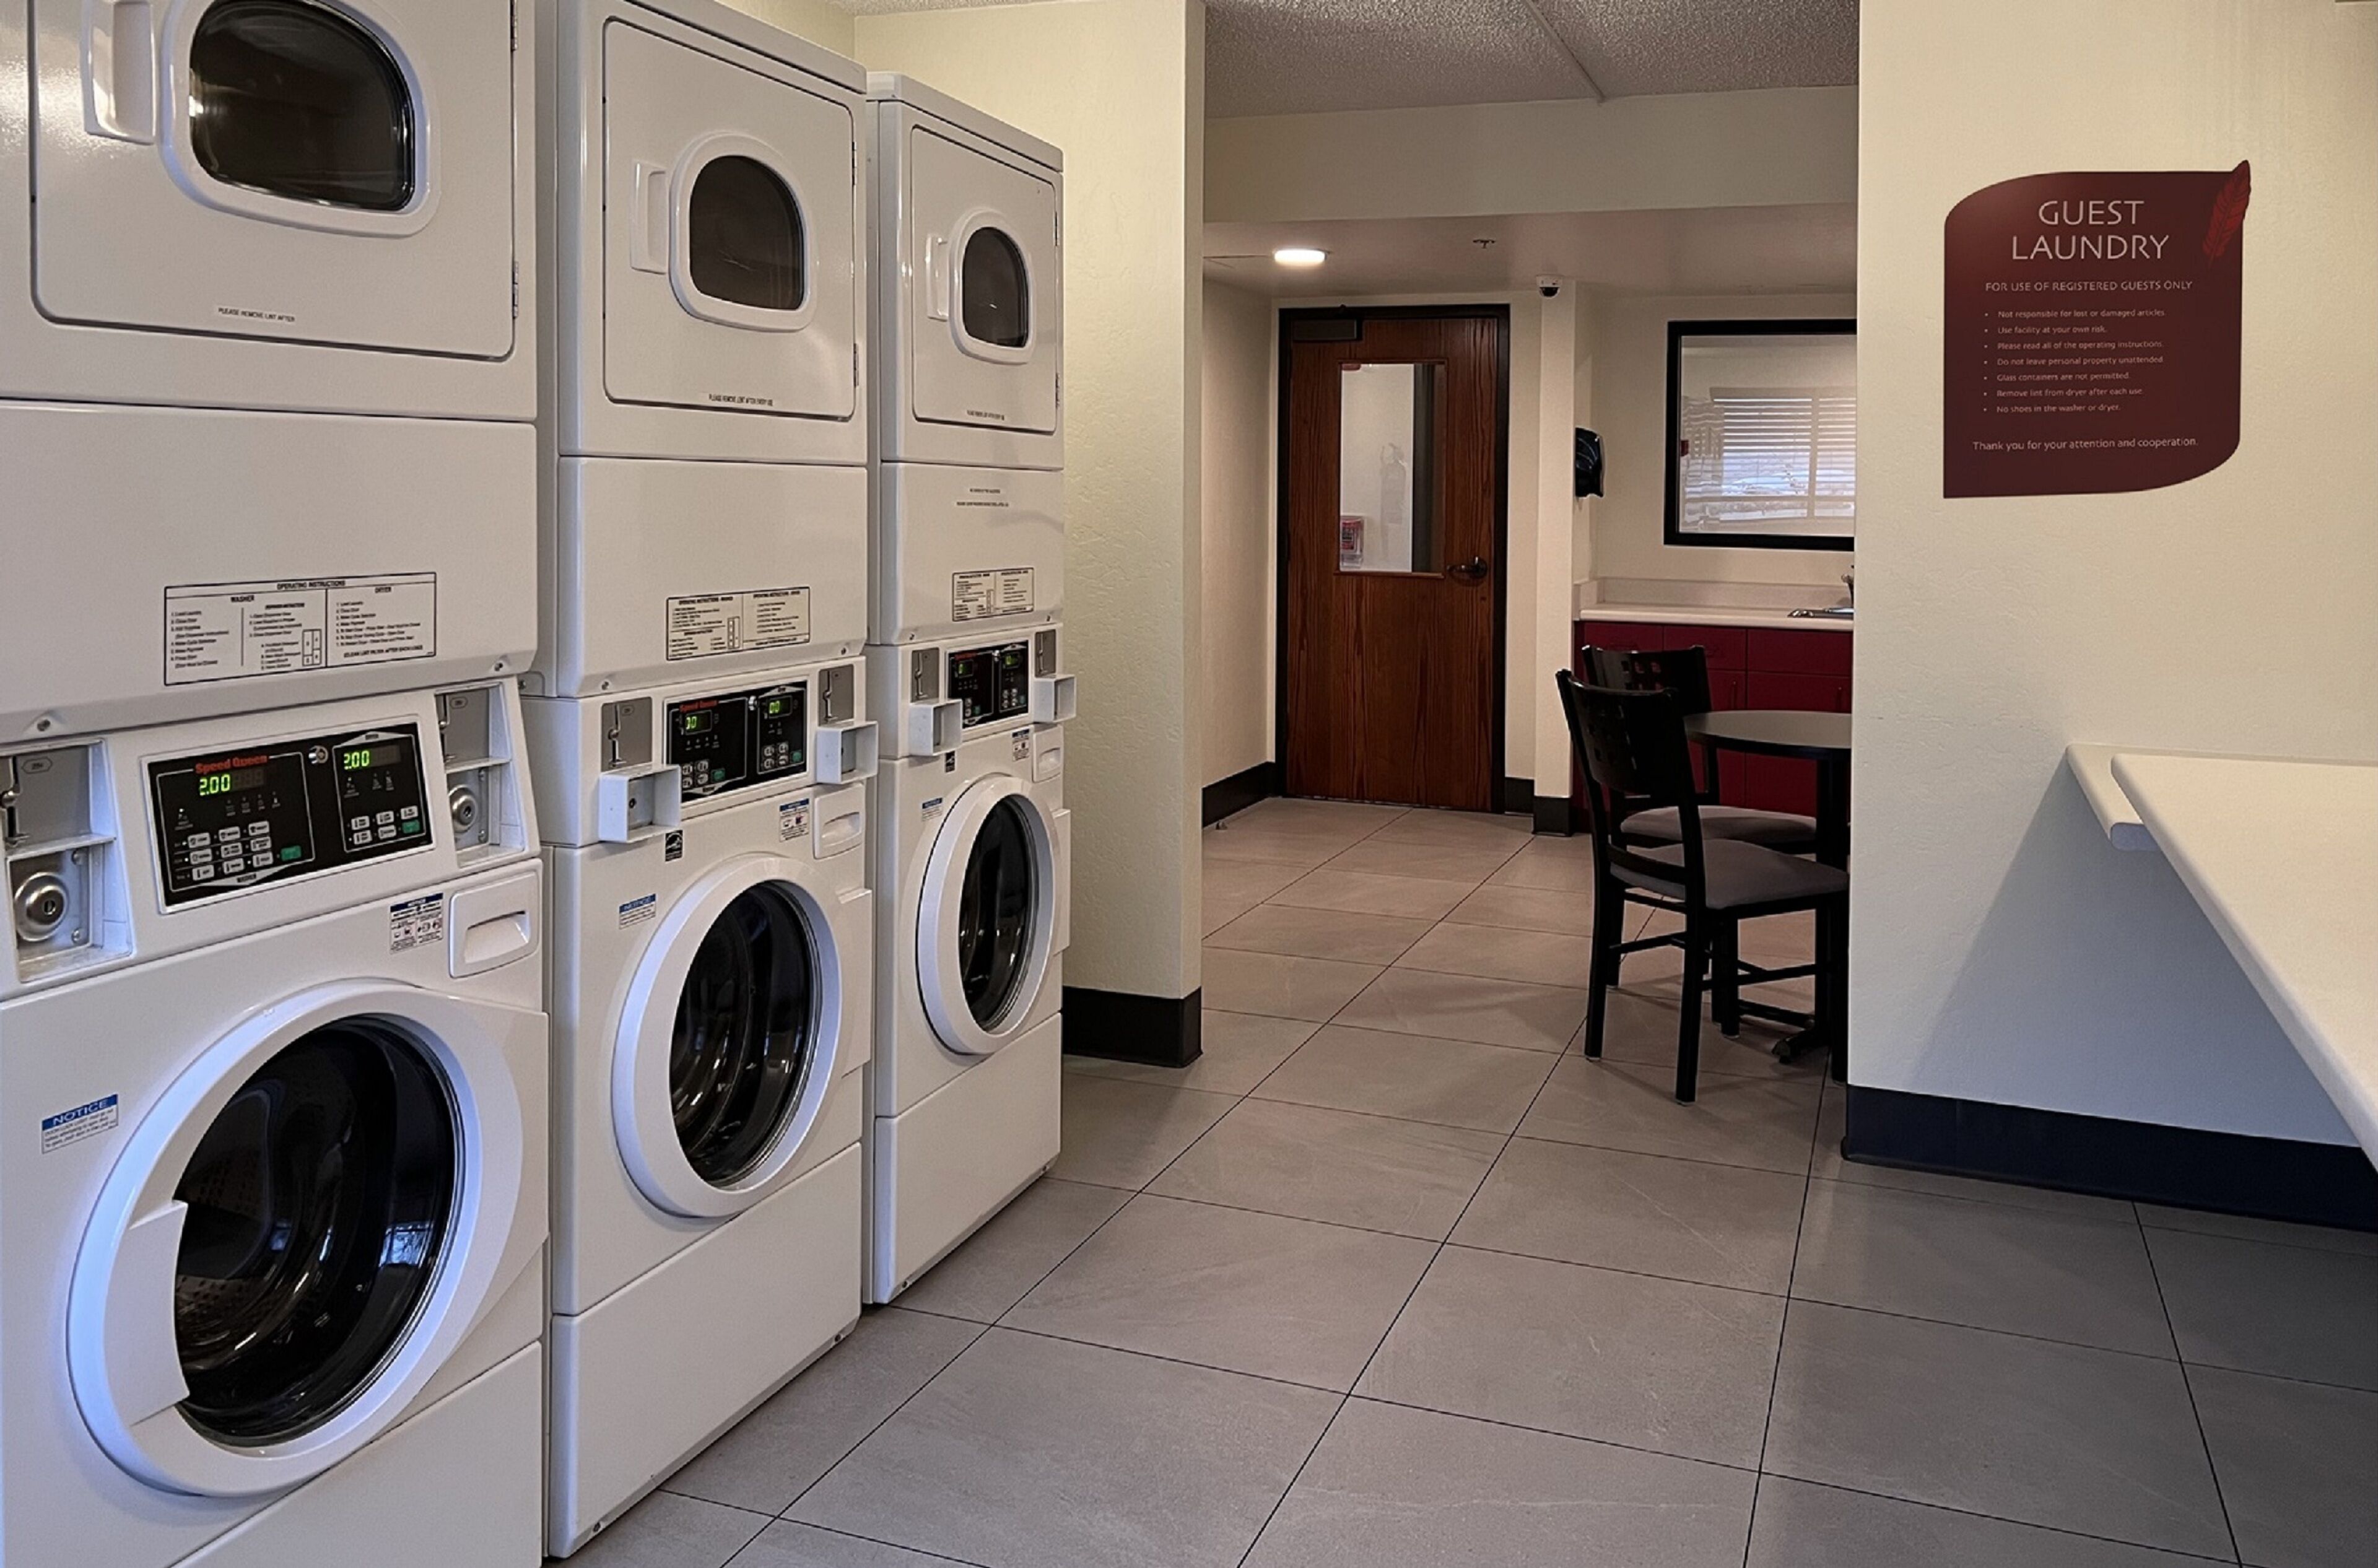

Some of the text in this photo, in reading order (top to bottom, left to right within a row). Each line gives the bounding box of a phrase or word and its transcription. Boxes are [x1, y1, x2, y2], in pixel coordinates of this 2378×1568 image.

[2039, 200, 2145, 225] GUEST
[2011, 235, 2169, 260] LAUNDRY
[1985, 280, 2193, 292] FOR USE OF REGISTERED GUESTS ONLY
[2015, 310, 2058, 319] responsible
[2100, 310, 2136, 318] damaged
[2014, 326, 2040, 335] facility
[2078, 341, 2115, 350] operating
[2048, 358, 2081, 366] personal
[2083, 357, 2117, 365] property
[2066, 389, 2087, 397] dryer
[2011, 405, 2032, 413] shoes
[1972, 441, 2003, 450] Thank
[2006, 442, 2024, 452] you
[2027, 440, 2042, 450] for
[2044, 441, 2067, 452] your
[2069, 439, 2115, 449] attention
[2117, 438, 2136, 448] and
[195, 755, 268, 774] Speed Queen
[199, 774, 230, 796] 2.00
[53, 1099, 107, 1126] NOTICE
